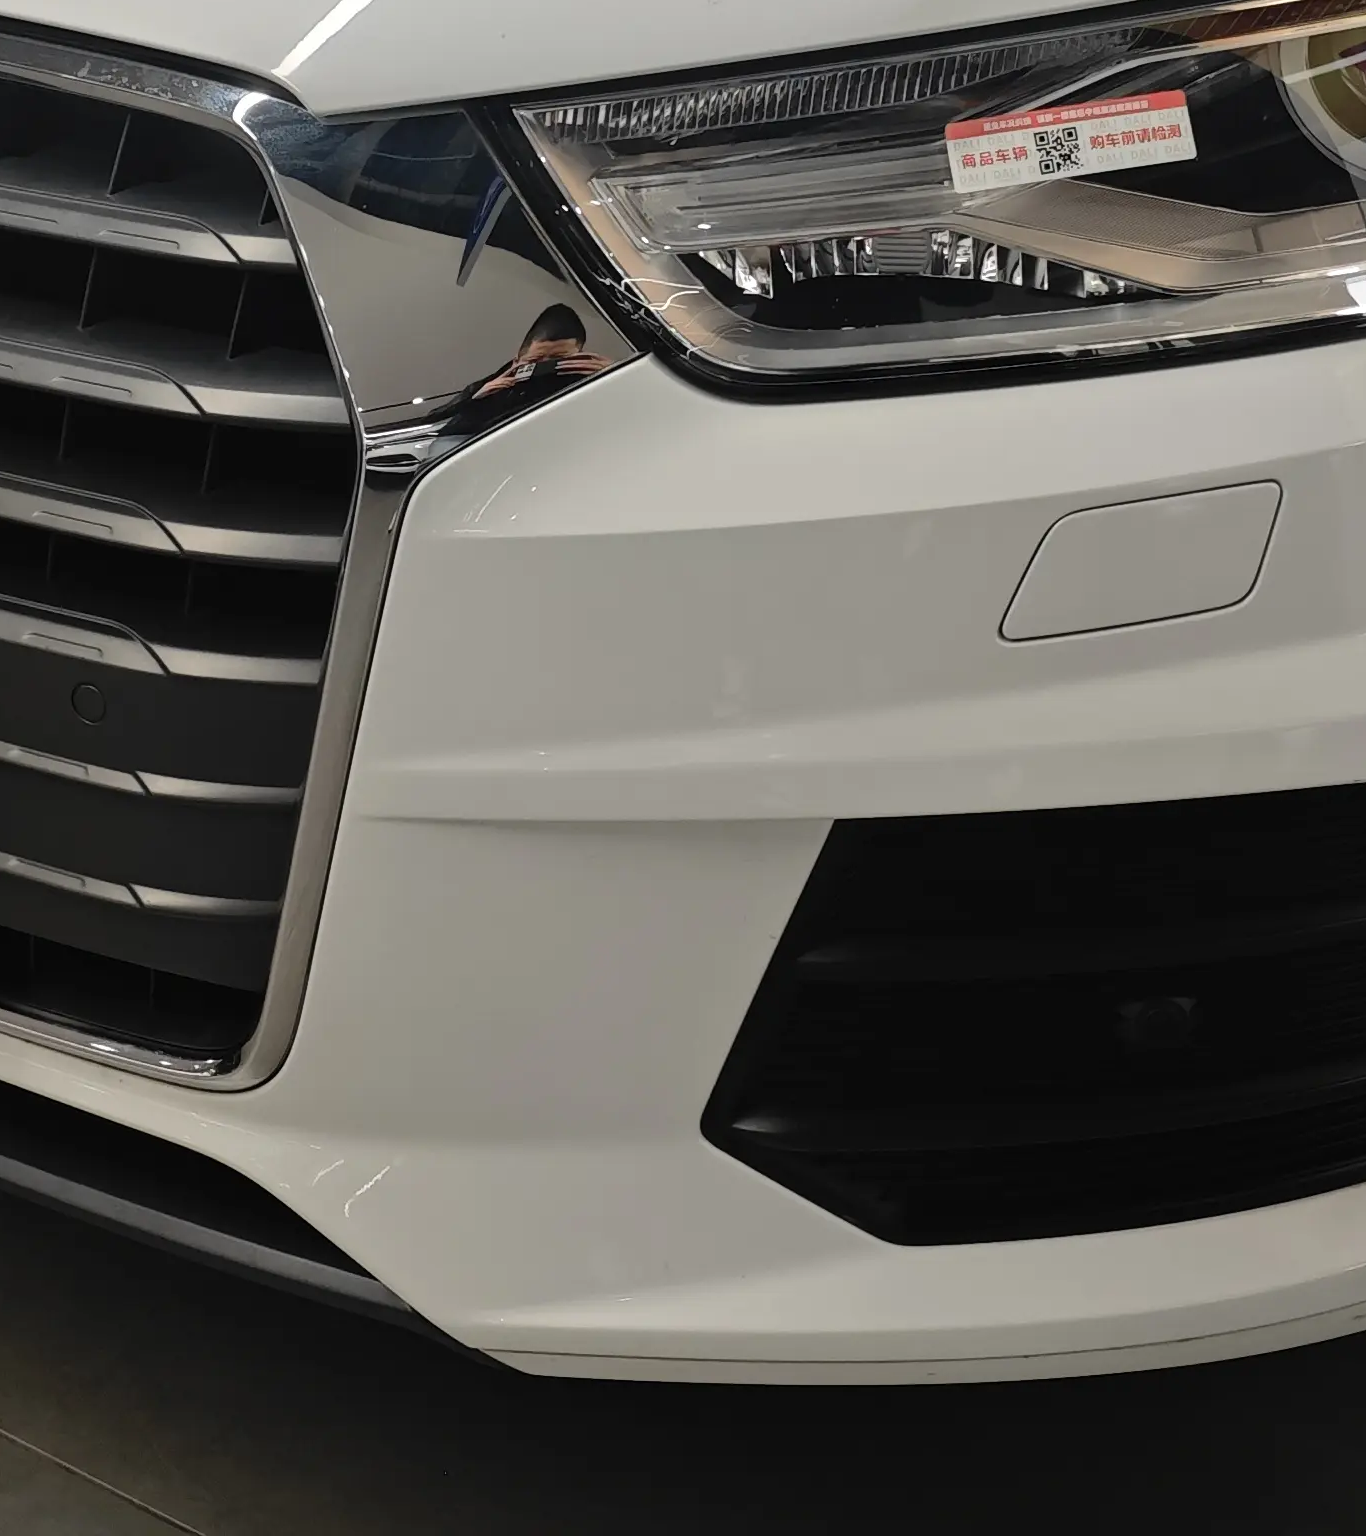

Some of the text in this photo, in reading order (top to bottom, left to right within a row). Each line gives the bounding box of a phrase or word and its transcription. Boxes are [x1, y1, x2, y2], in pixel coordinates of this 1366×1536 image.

[961, 124, 1182, 169] 商品车辆 购车前请检测
